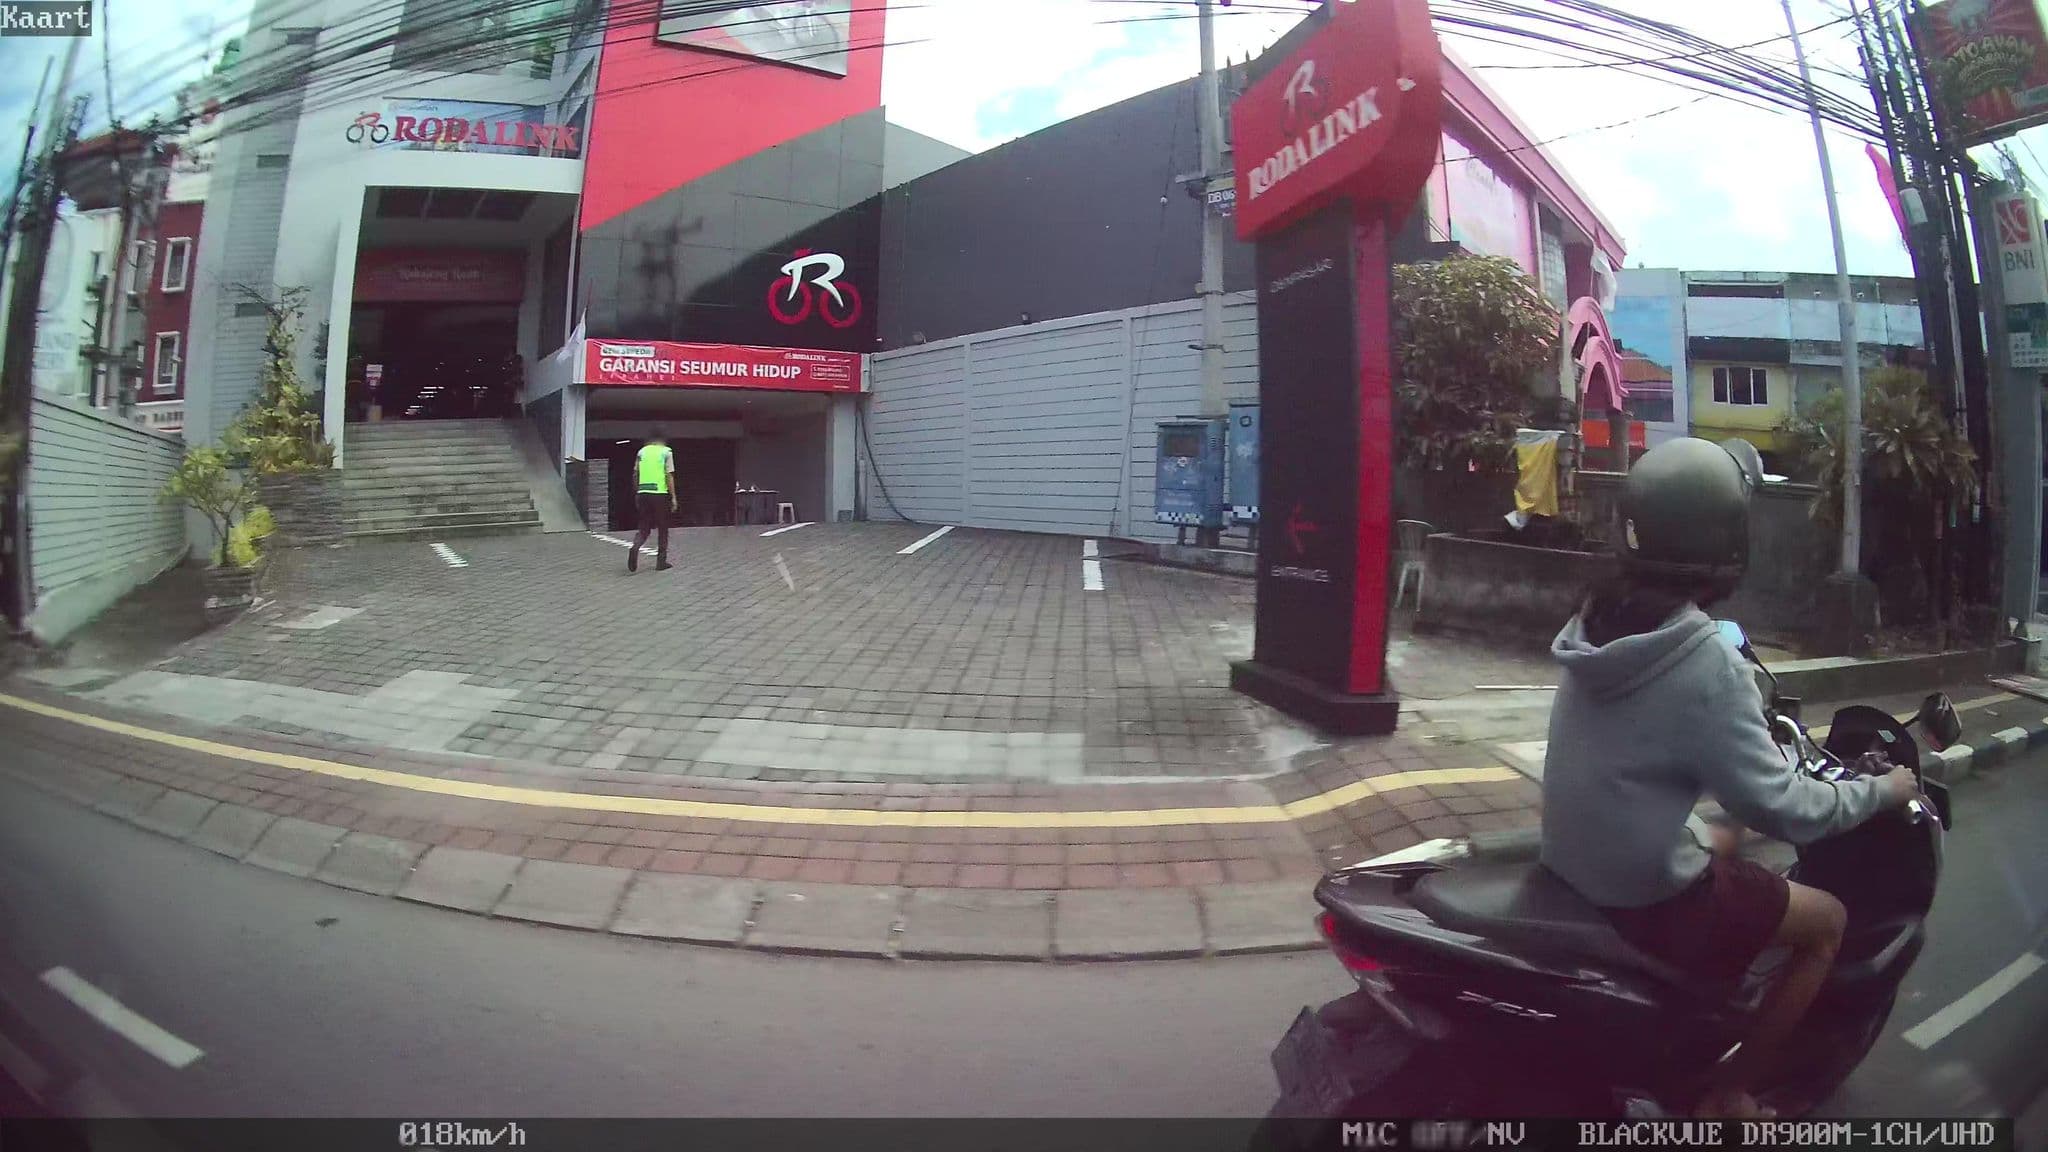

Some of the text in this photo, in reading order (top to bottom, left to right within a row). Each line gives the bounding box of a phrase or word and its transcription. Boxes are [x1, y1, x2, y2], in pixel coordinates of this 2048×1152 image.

[390, 115, 579, 150] RODALINK
[1247, 86, 1382, 200] RODALINK
[2004, 250, 2035, 272] BNI
[600, 358, 675, 374] GARANSI
[680, 360, 748, 377] SEUMUR
[752, 364, 802, 379] HIDUP
